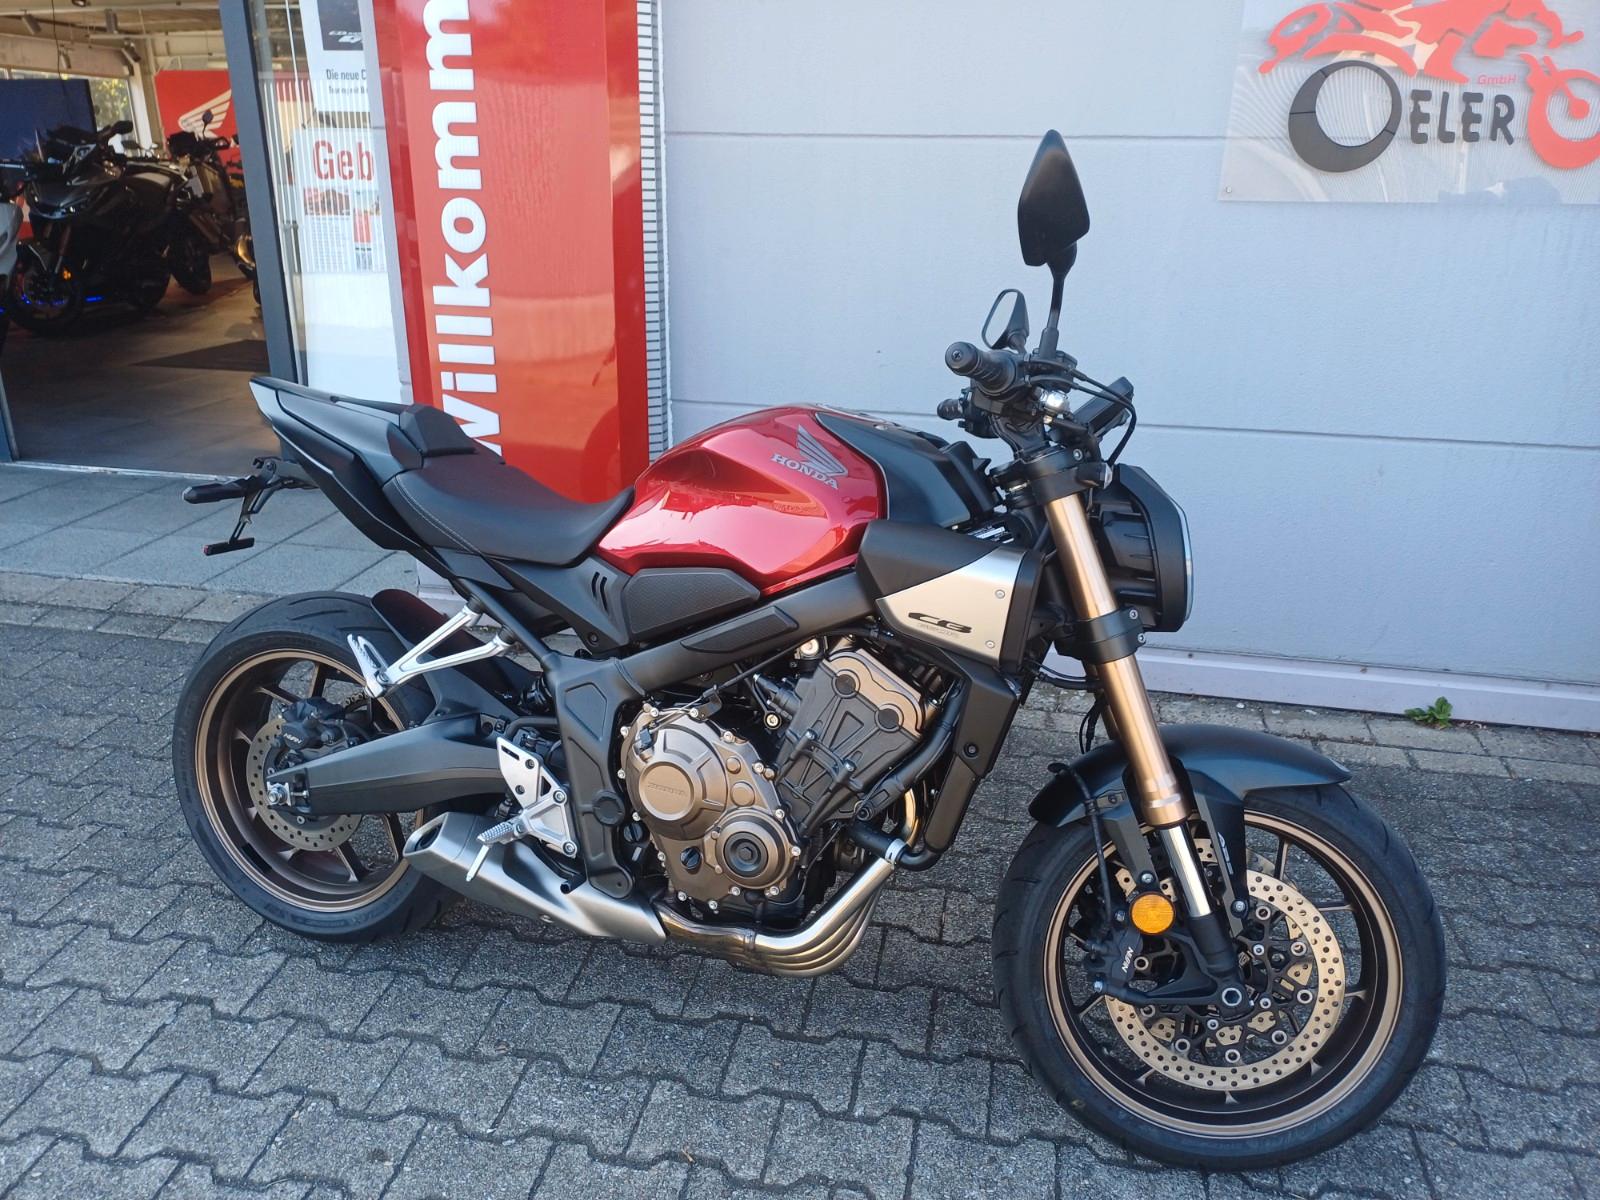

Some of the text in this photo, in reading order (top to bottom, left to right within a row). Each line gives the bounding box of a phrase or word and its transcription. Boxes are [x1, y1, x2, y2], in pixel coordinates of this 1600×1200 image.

[326, 68, 339, 80] Die
[340, 70, 360, 80] neue
[312, 139, 374, 181] Geb
[770, 453, 838, 490] HONDA
